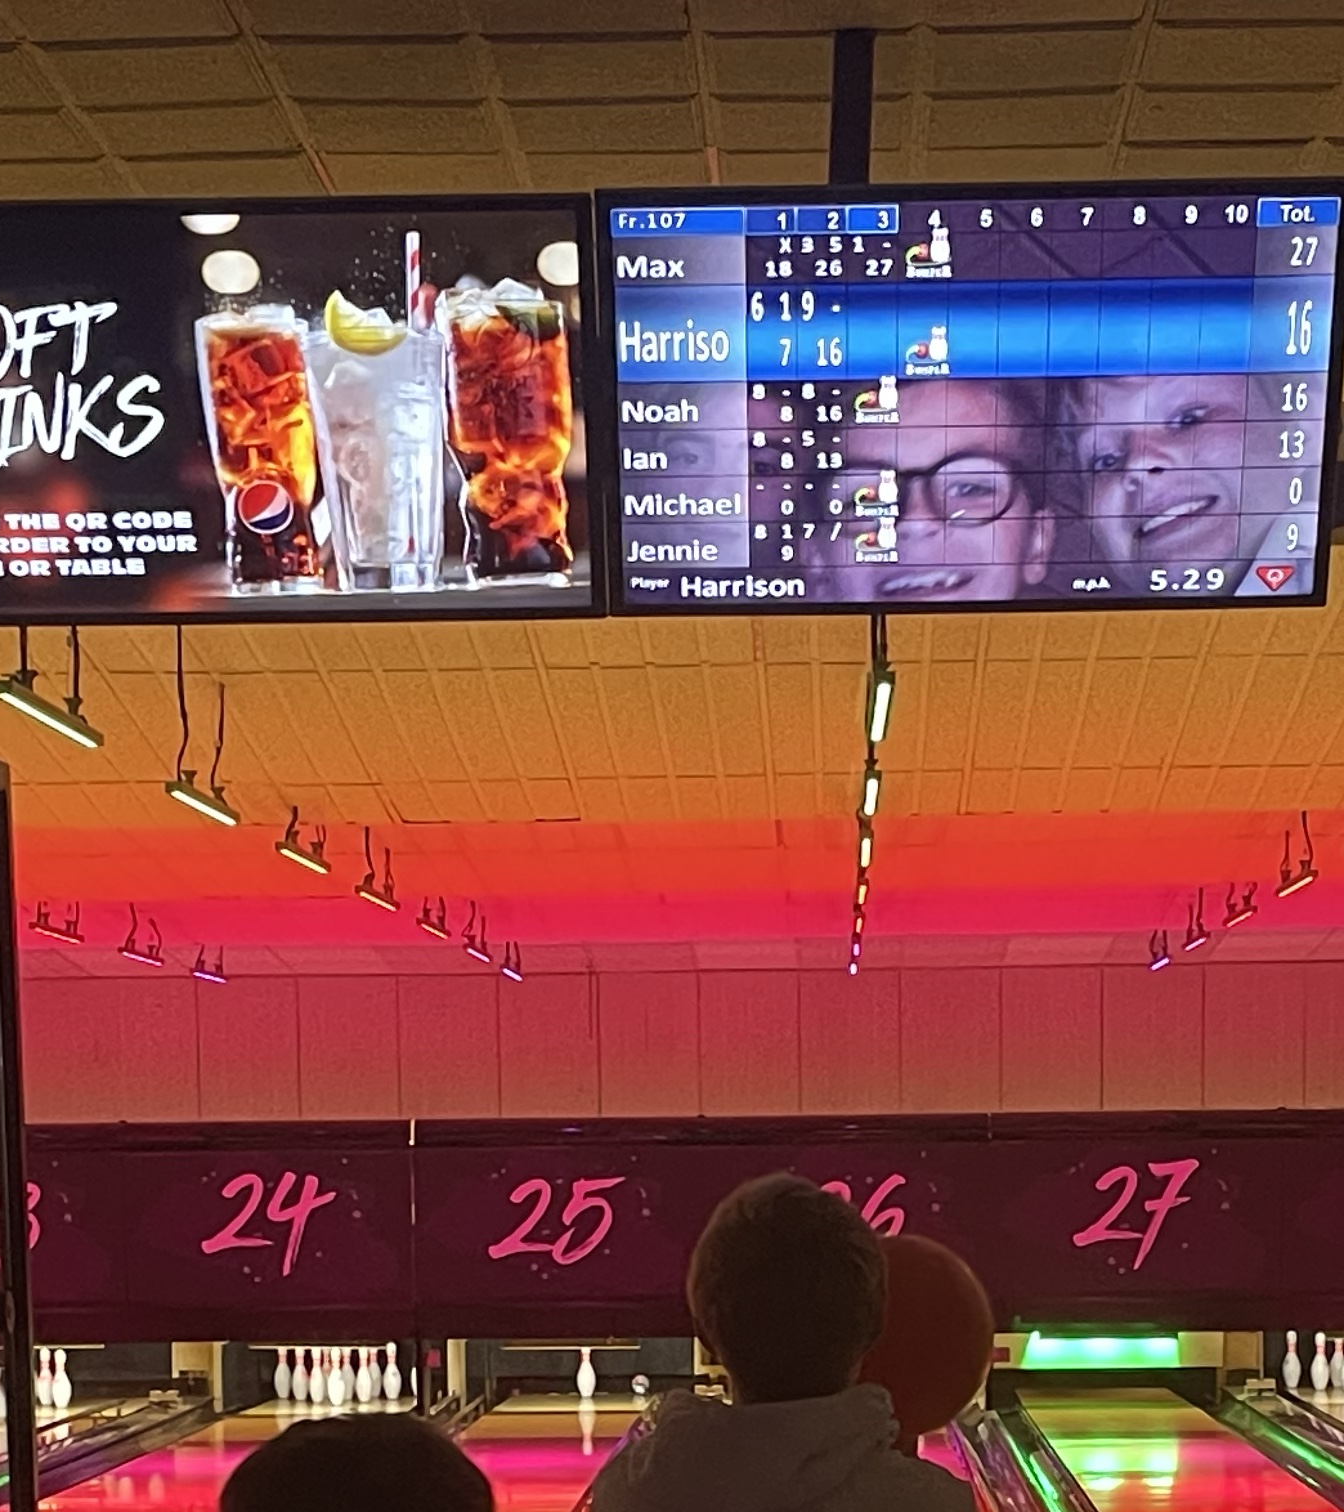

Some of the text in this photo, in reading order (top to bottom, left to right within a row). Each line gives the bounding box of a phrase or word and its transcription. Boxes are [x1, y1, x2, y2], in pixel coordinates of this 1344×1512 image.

[617, 204, 1316, 231] Fr.107 1 2 3 4 5 6 7 8 9 10 Tot.
[616, 256, 685, 278] Max
[765, 260, 793, 277] 18
[815, 260, 843, 277] 26
[865, 259, 893, 276] 27
[1290, 236, 1319, 267] 27
[619, 300, 1313, 367] Harriso 7 16 16
[621, 399, 700, 424] Noah
[780, 405, 794, 422] 8
[816, 405, 843, 422] 16
[1282, 383, 1308, 412] 16
[623, 448, 668, 471] Ian
[817, 452, 843, 469] 13
[1279, 430, 1305, 459] 13
[624, 493, 742, 516] Michael
[781, 499, 794, 516] 0
[829, 499, 843, 516] 0
[1289, 477, 1303, 505] 0
[4, 513, 60, 530] THE
[65, 512, 107, 532] QR
[112, 511, 192, 530] CODE
[74, 536, 112, 553] TO
[117, 534, 197, 552] YOUR
[626, 522, 1299, 564] Jennie 9 9
[9, 559, 51, 577] OR
[55, 558, 146, 576] TABLE
[680, 575, 805, 599] Harrison
[1149, 568, 1225, 591] 5.29
[201, 1171, 336, 1276] 24
[488, 1177, 626, 1265] 25
[1073, 1159, 1199, 1270] 27
